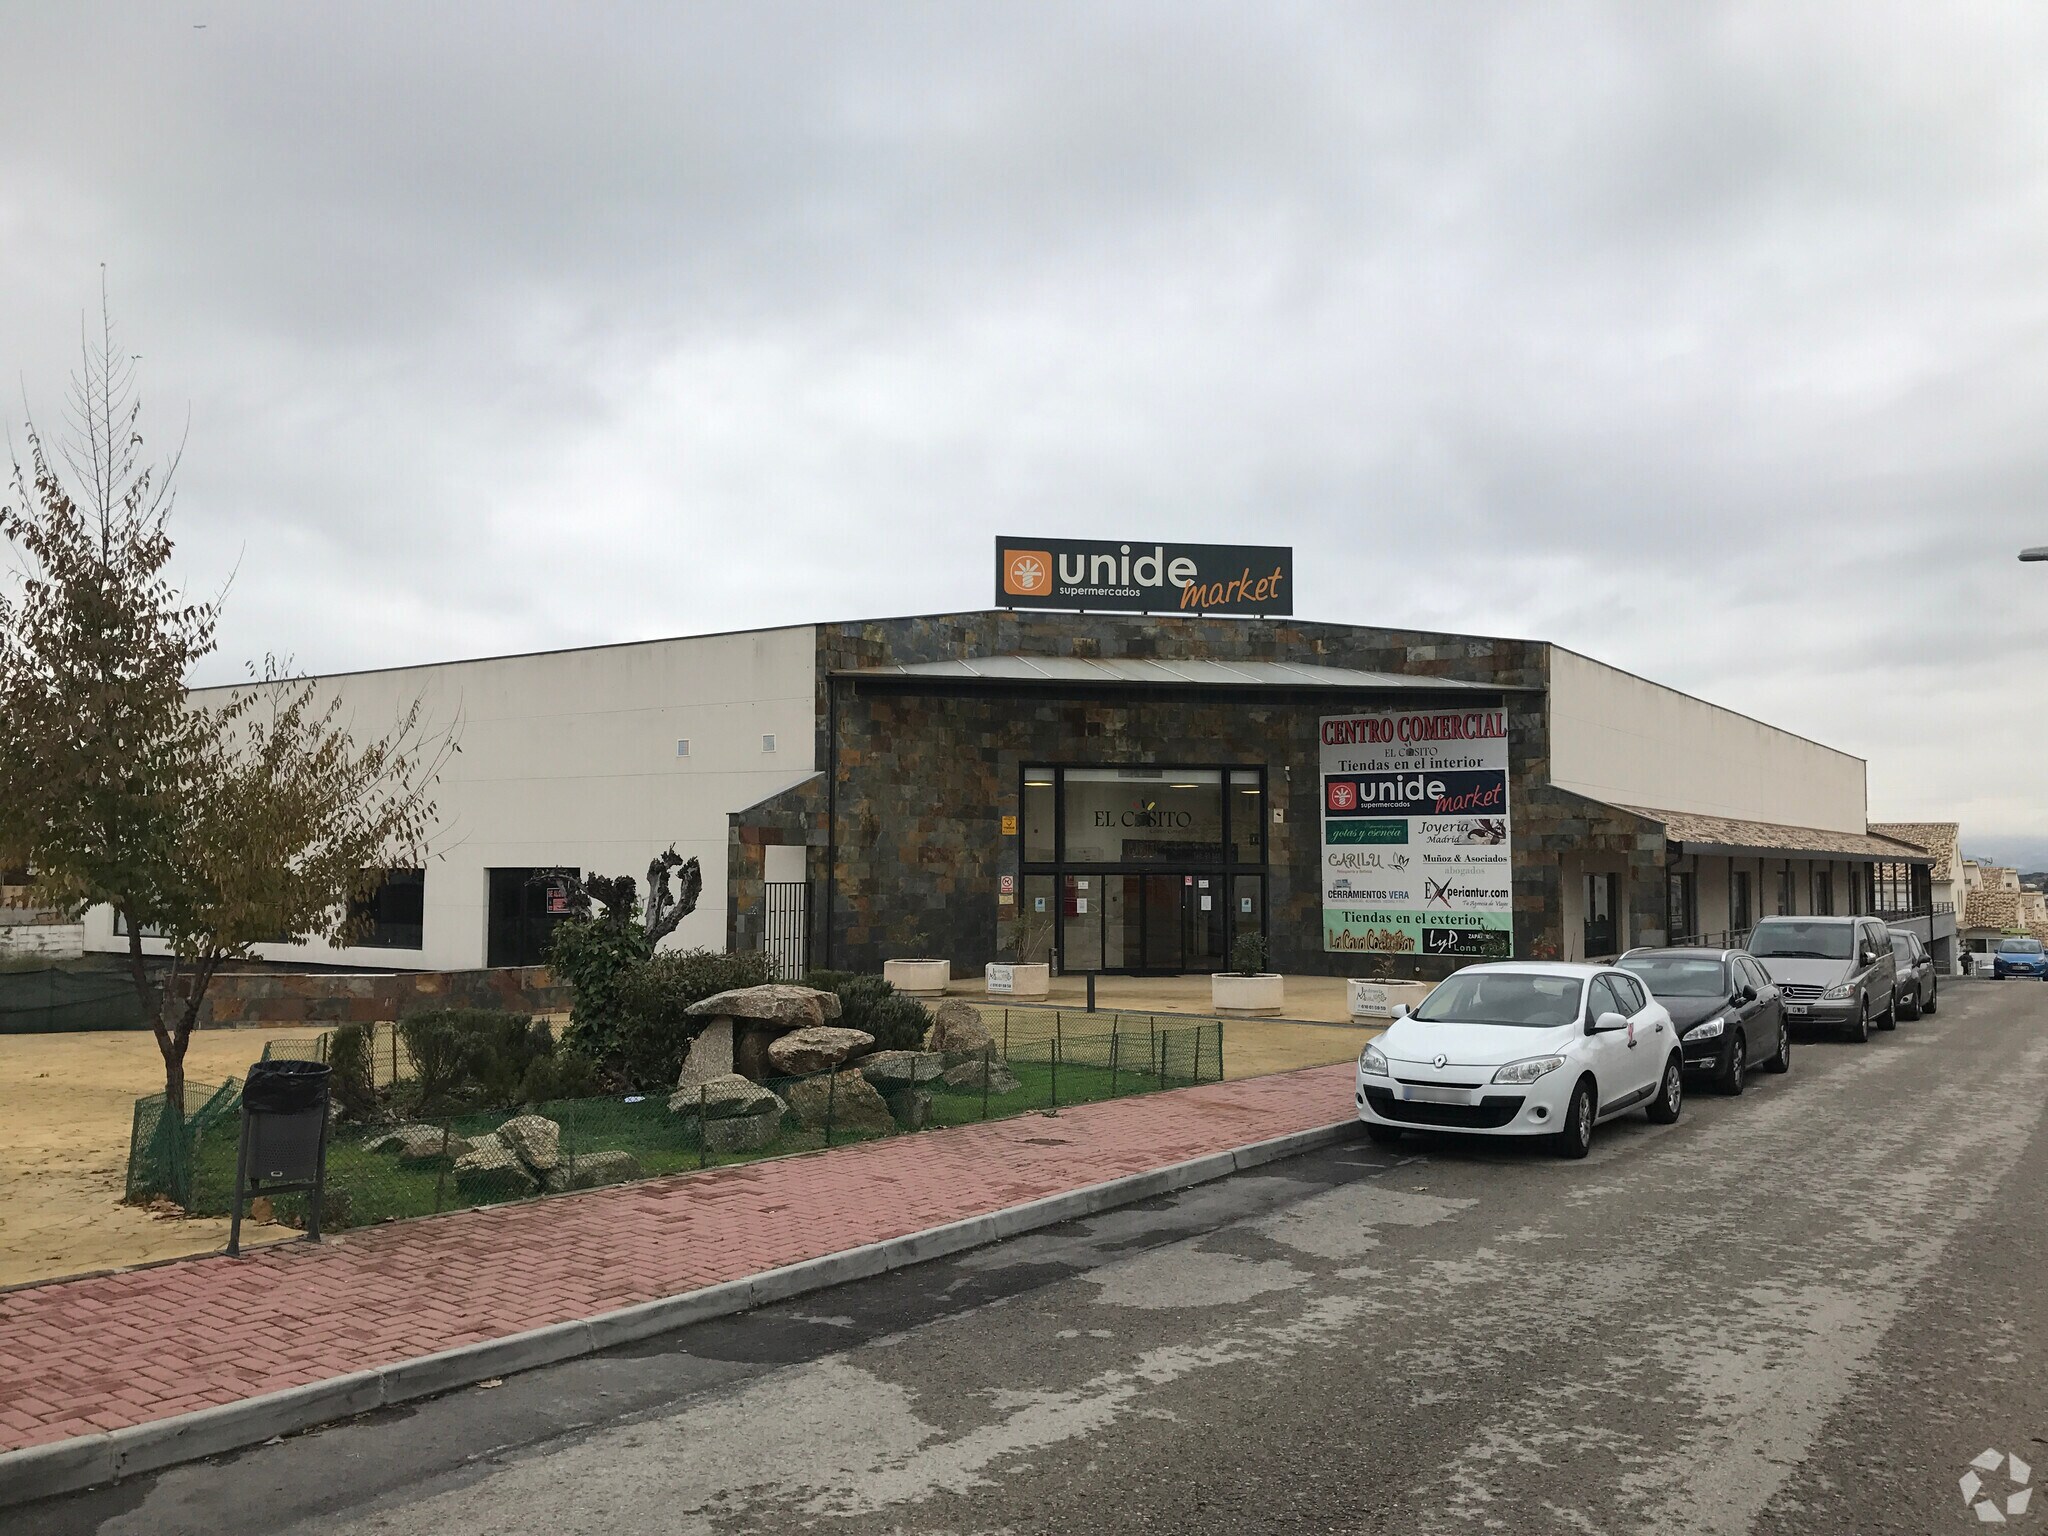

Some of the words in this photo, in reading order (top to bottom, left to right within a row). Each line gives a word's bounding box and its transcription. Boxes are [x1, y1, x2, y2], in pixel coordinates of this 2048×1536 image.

[1058, 544, 1198, 588] unide
[1059, 586, 1141, 598] supermercados
[1179, 566, 1283, 609] market
[1321, 717, 1394, 745] CENTRO
[1396, 712, 1507, 742] COMERCIAL
[1384, 748, 1396, 758] EL
[1338, 759, 1390, 771] Tiendas
[1394, 760, 1409, 770] en
[1413, 757, 1425, 769] el
[1430, 756, 1484, 769] interior
[1359, 774, 1446, 801] unide
[1360, 801, 1411, 809] supermercados
[1434, 782, 1503, 814] market
[1093, 811, 1116, 827] EL
[1330, 828, 1357, 842] gotas
[1355, 829, 1366, 842] y
[1367, 827, 1402, 837] esencia
[1426, 834, 1462, 844] Madrid
[1328, 852, 1385, 870] CARILU
[1422, 853, 1452, 863] Muñoz
[1453, 854, 1462, 863] &
[1463, 854, 1508, 863] Asociados
[1444, 866, 1486, 875] abogados
[1327, 890, 1387, 899] CERRAMIENTOS
[1388, 890, 1410, 900] VERA
[1341, 911, 1392, 923] Tiendas
[1395, 913, 1411, 924] en
[1415, 912, 1426, 924] el
[1430, 913, 1484, 926] exterior
[1329, 928, 1342, 950] La
[1429, 929, 1459, 954] LyP
[1453, 943, 1477, 952] Lona
